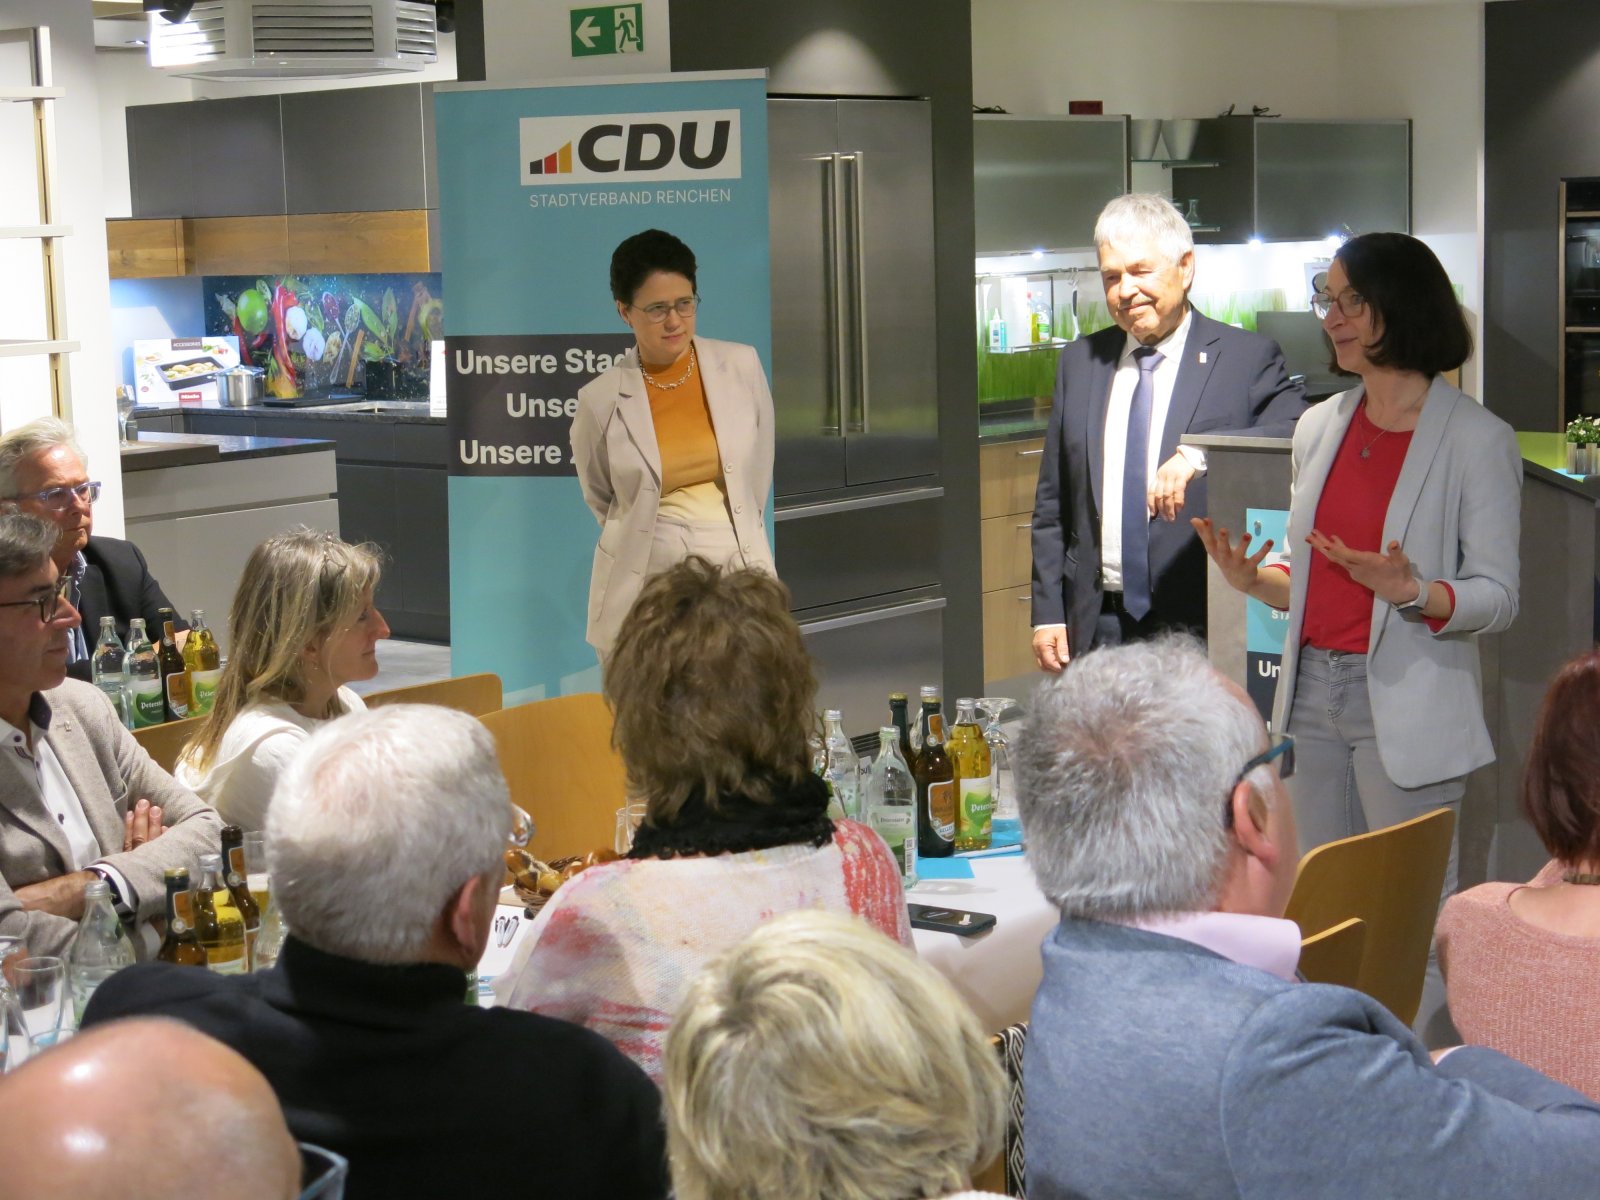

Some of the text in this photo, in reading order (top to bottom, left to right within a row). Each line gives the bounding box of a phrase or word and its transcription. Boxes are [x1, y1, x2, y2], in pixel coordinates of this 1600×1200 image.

[578, 120, 730, 173] CDU
[529, 188, 731, 208] STADTVERBAND RENCHEN
[455, 350, 557, 375] Unsere
[459, 439, 562, 465] Unsere
